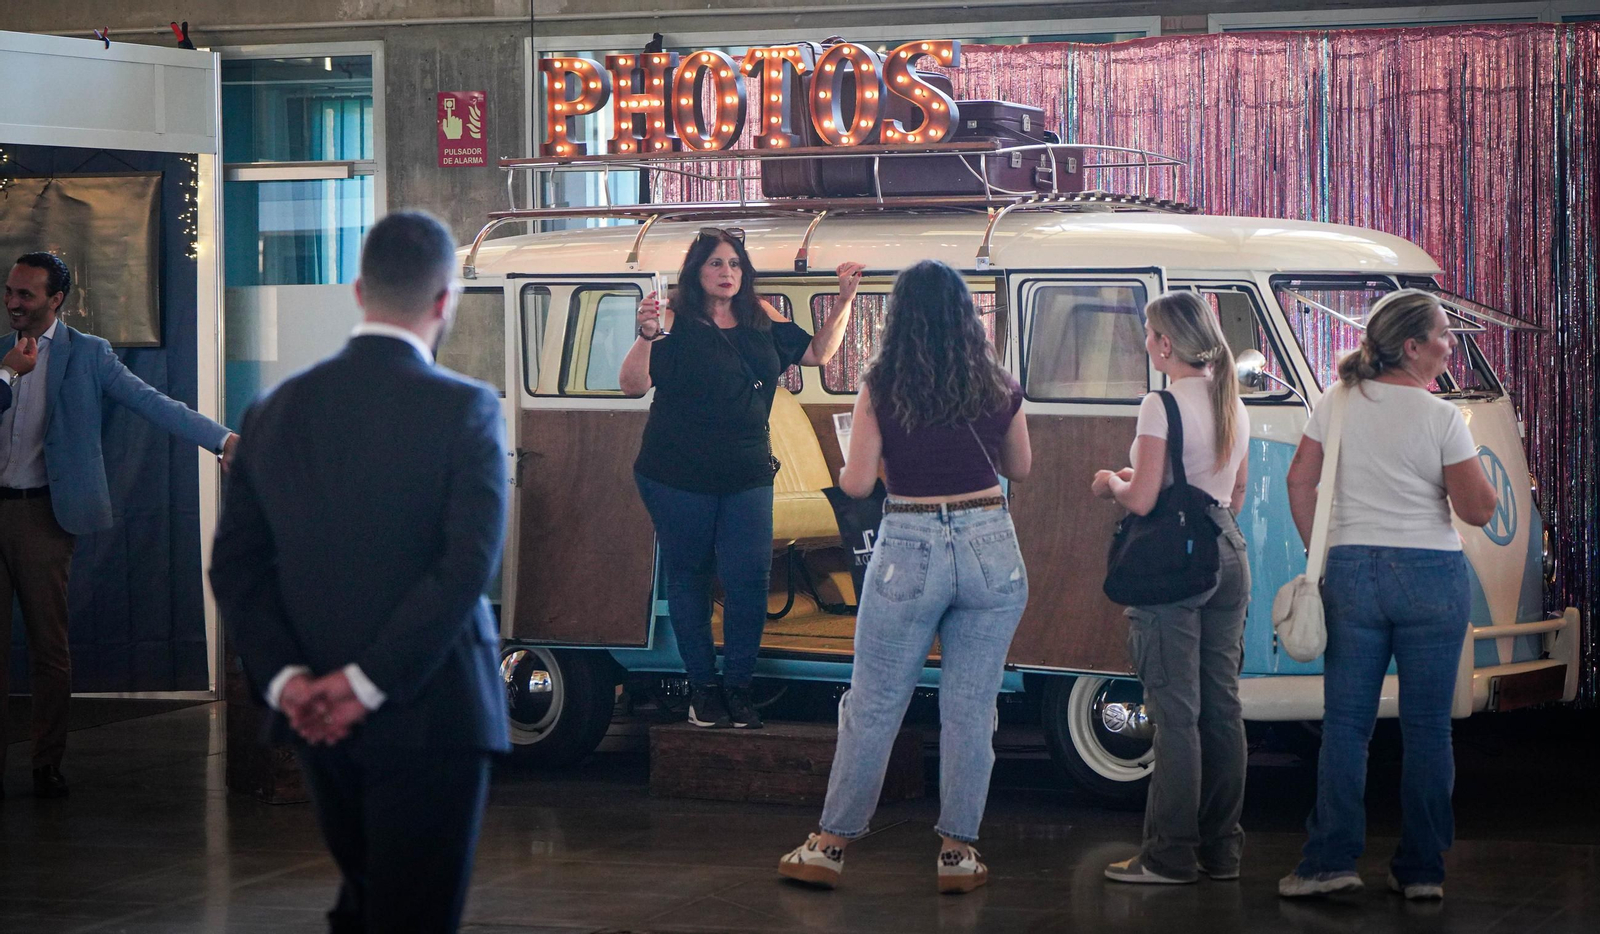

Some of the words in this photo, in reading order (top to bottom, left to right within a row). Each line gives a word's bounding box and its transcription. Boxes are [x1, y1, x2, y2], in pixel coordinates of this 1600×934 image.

[538, 39, 960, 156] PHOTOS
[444, 147, 482, 156] PULSADOR
[443, 157, 453, 165] DE
[454, 156, 483, 164] ALARMA
